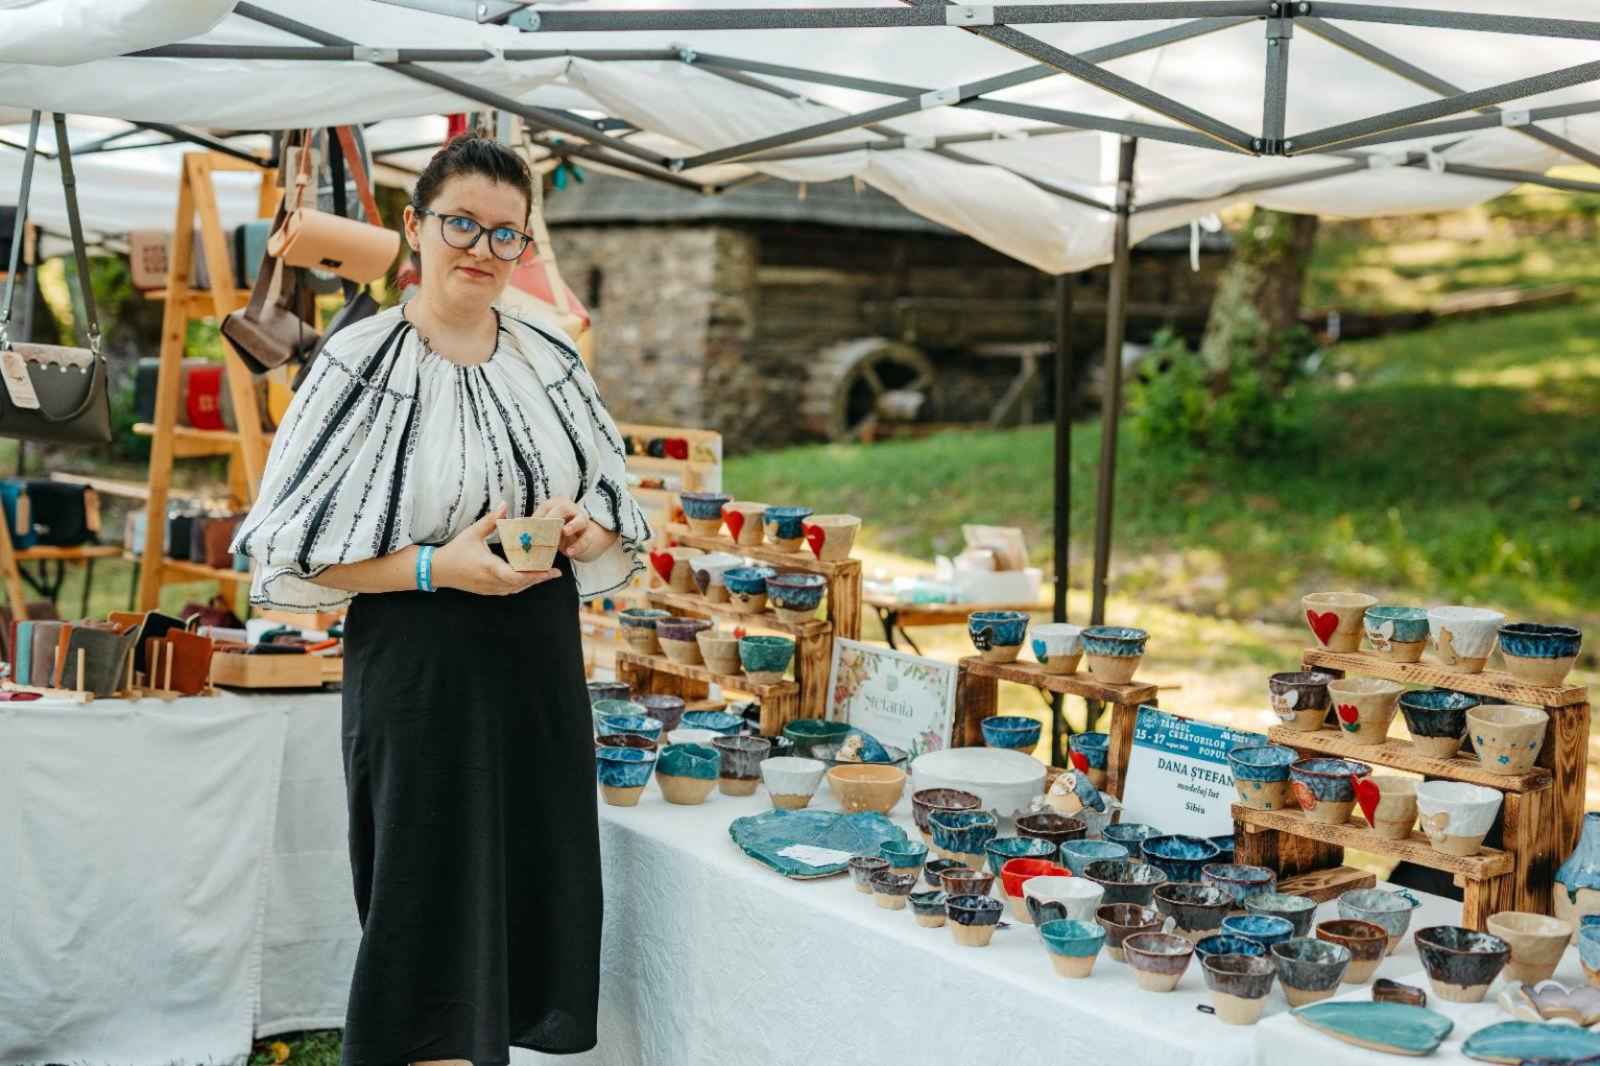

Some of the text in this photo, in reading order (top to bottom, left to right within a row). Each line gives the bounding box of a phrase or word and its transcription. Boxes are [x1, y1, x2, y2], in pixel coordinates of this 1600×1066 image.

[1135, 729, 1148, 740] 15
[1153, 733, 1166, 744] 17
[1157, 757, 1188, 776] DANA
[1185, 801, 1206, 814] Sibiu
